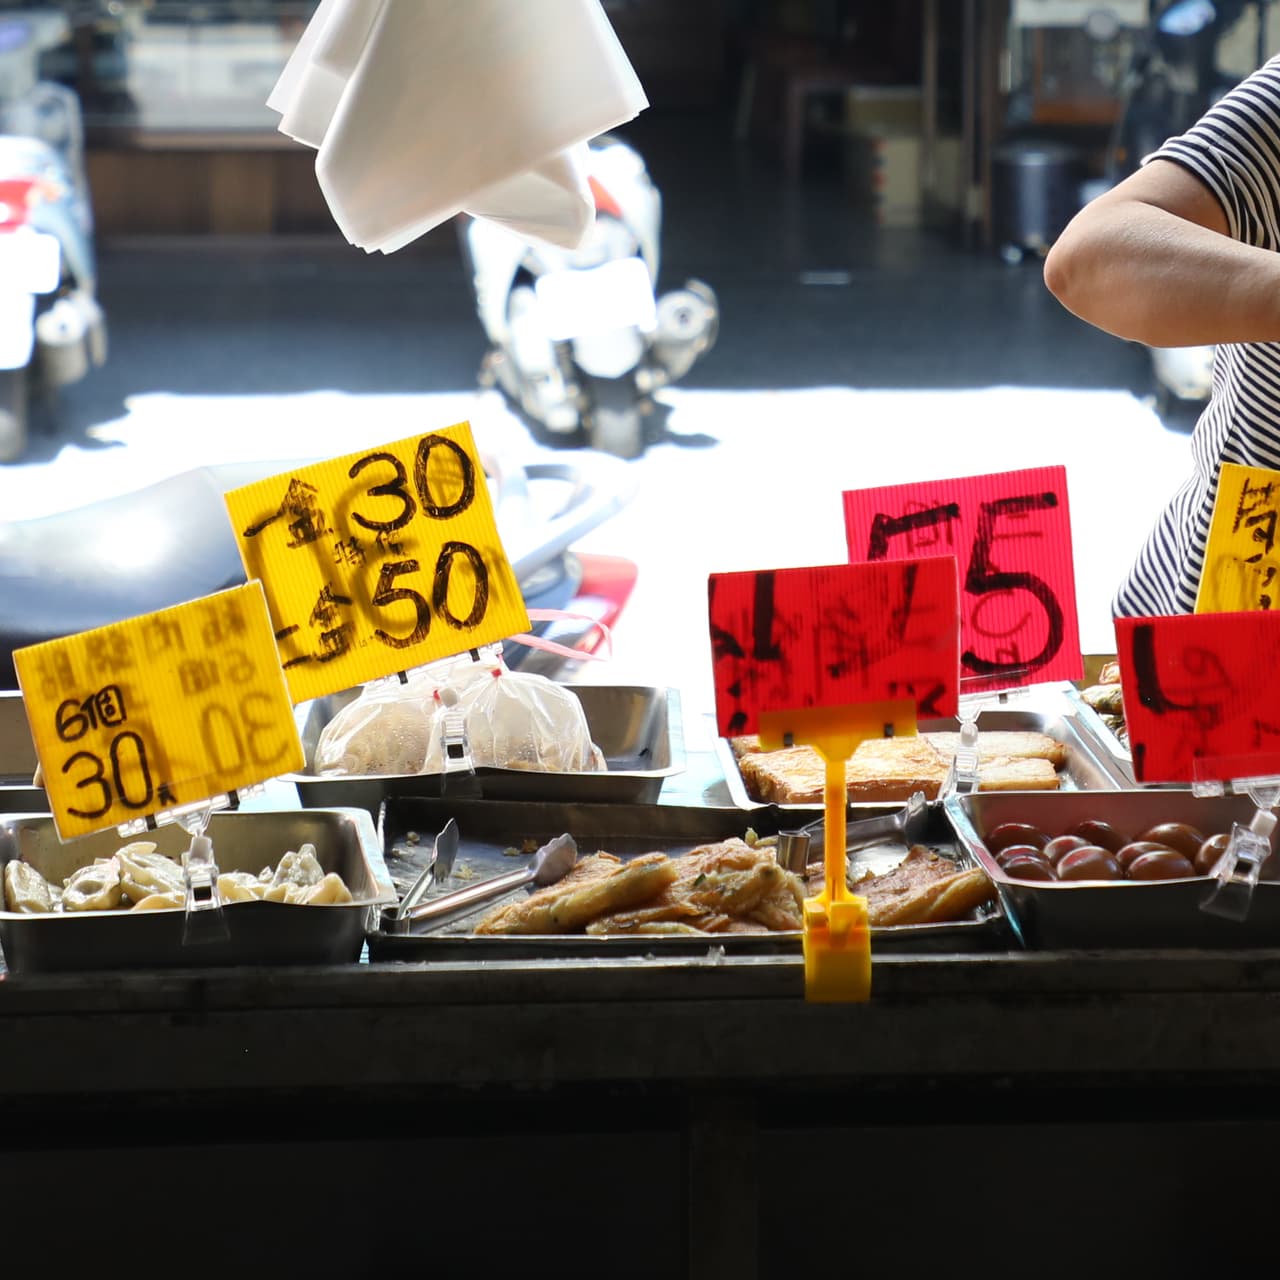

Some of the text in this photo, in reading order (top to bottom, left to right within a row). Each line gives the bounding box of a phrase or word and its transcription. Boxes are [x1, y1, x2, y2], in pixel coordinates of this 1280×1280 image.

[349, 434, 475, 532] 30
[372, 541, 489, 650] 50
[55, 685, 127, 743] 6個
[62, 731, 153, 819] 30
